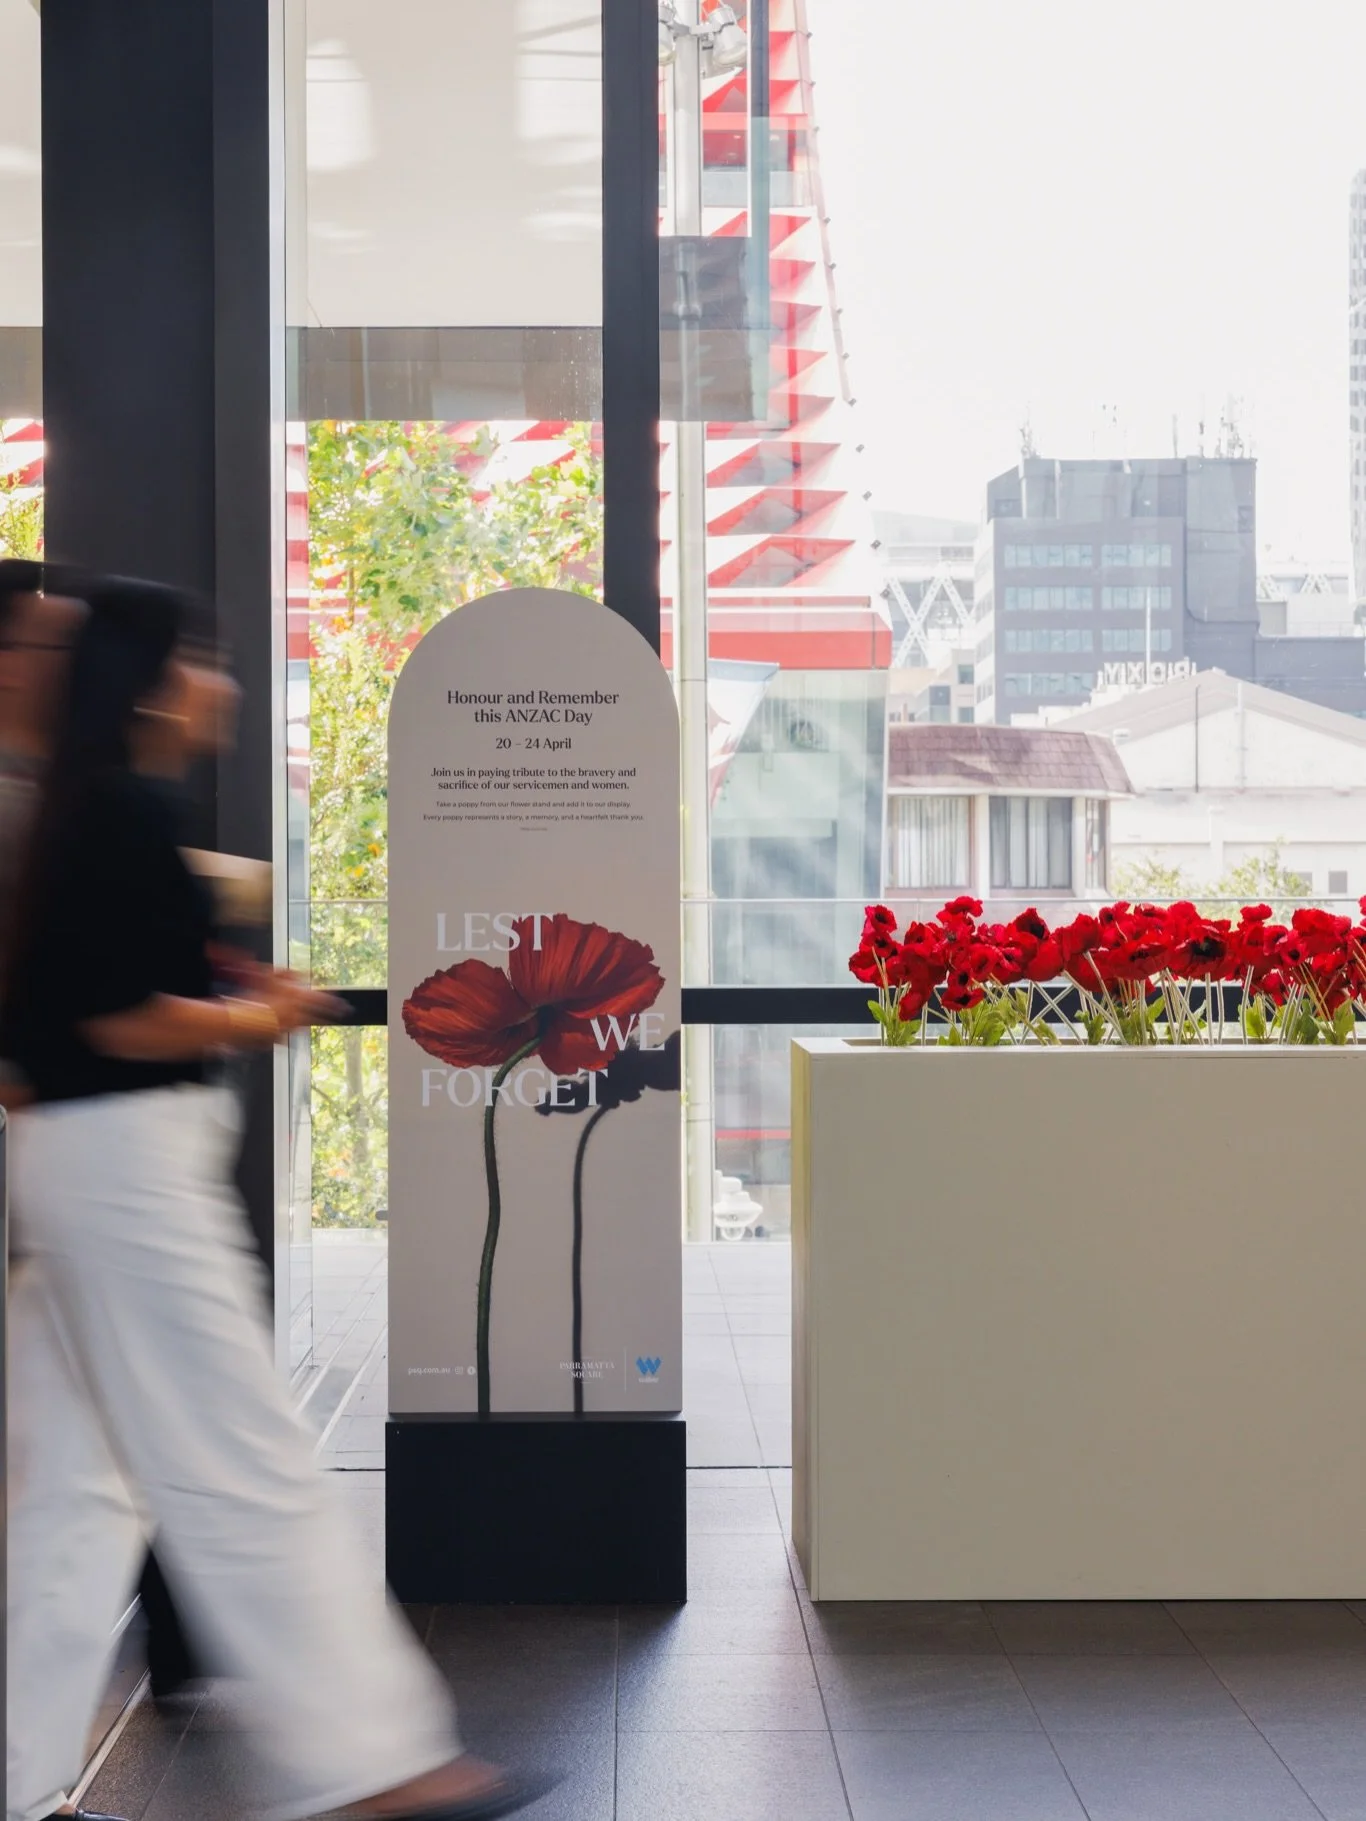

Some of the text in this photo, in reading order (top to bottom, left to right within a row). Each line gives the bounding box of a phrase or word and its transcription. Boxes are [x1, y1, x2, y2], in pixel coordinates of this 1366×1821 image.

[448, 690, 619, 704] Honour and Remember
[475, 709, 592, 726] this ANZAC Day
[496, 738, 511, 749] 20
[525, 738, 539, 749] 24
[543, 738, 571, 751] April
[431, 768, 451, 776] Join
[467, 768, 475, 776] in
[478, 768, 510, 779] paying
[513, 768, 545, 776] tribute
[561, 768, 576, 776] the
[578, 768, 615, 779] bravery
[618, 768, 636, 776] and
[438, 780, 478, 789] sacrifice
[481, 780, 492, 789] of
[513, 780, 568, 789] servicemen
[571, 780, 589, 789] and
[424, 814, 441, 822] Every
[436, 912, 553, 951] LEST
[590, 1013, 665, 1051] WE
[421, 1068, 608, 1107] FORGET
